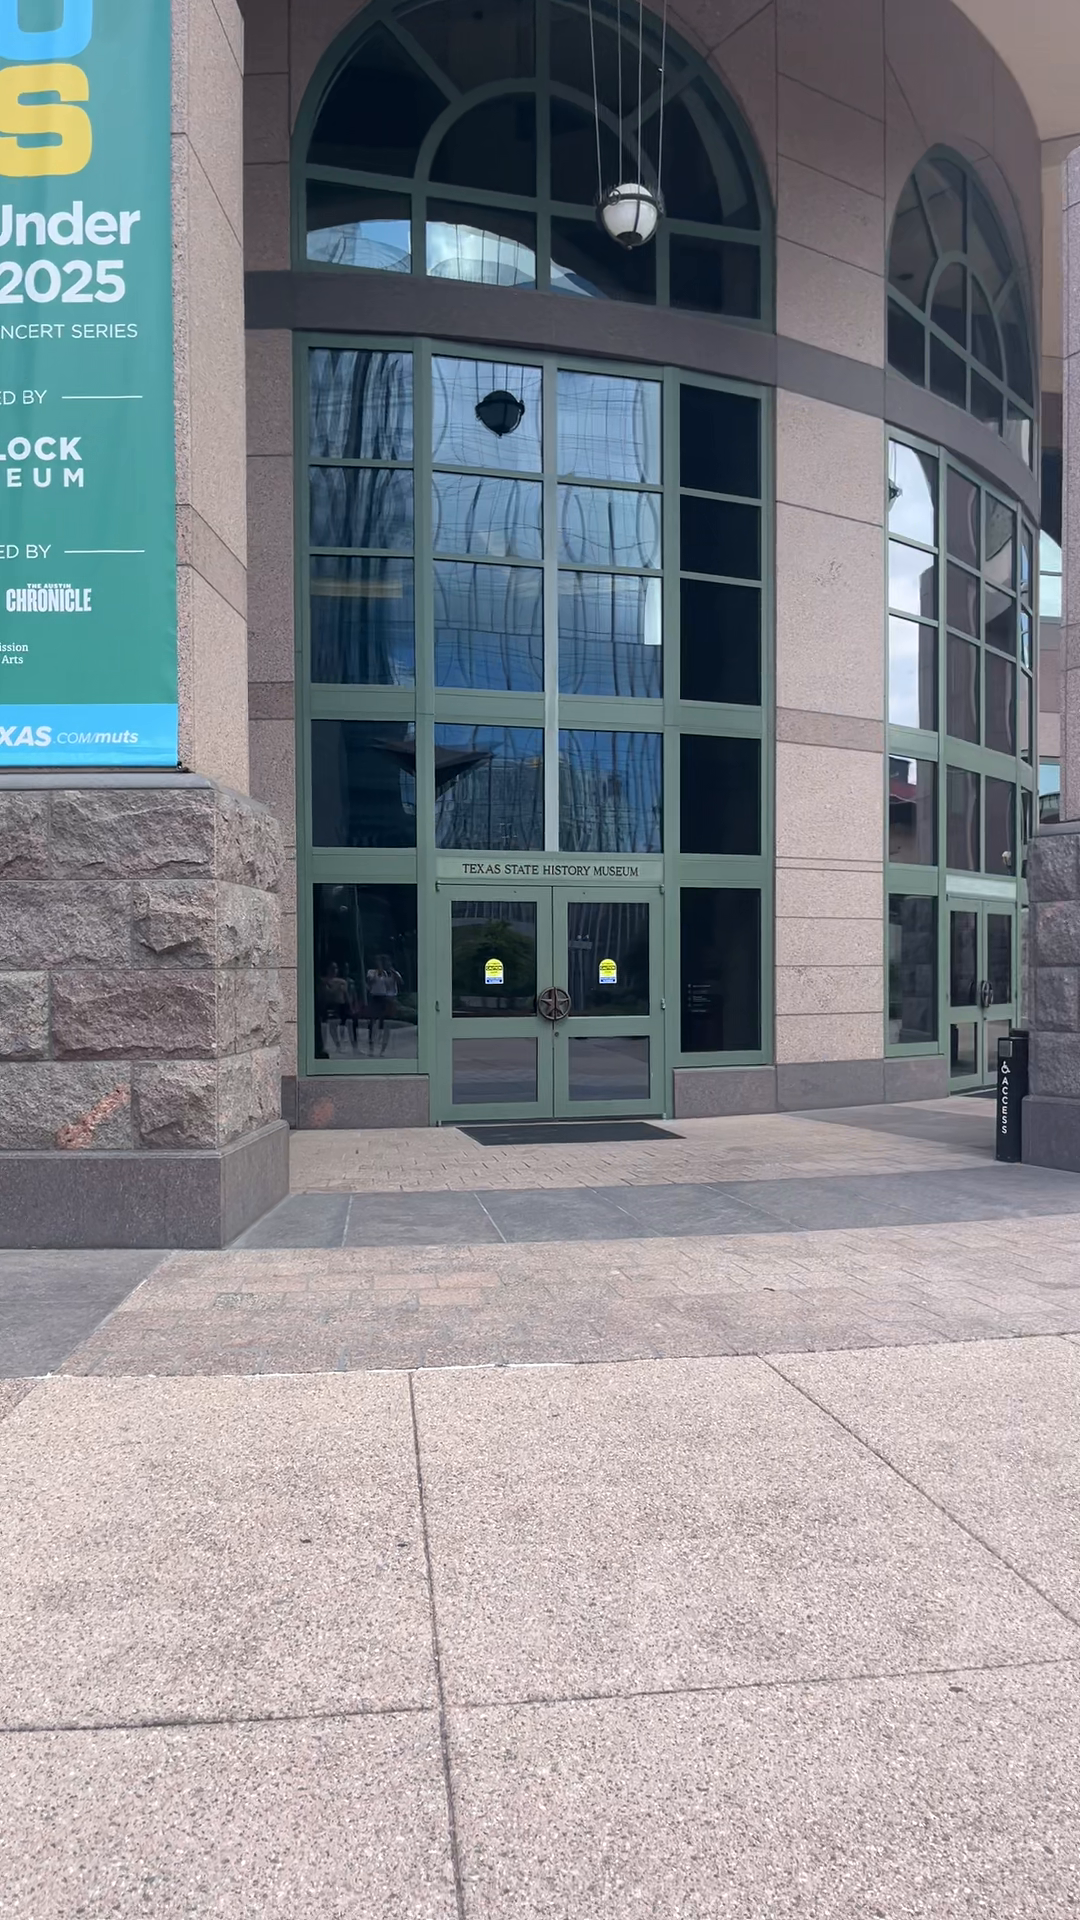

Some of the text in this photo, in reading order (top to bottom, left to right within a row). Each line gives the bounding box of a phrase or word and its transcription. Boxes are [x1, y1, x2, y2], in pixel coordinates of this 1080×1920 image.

[0, 63, 93, 177] S
[0, 259, 126, 304] 2025
[71, 323, 138, 339] SERIES
[22, 390, 47, 405] BY
[26, 544, 51, 559] BY
[6, 588, 92, 612] CHRONICLE
[1, 654, 24, 665] Arts
[462, 863, 639, 877] TEXAS STATE HISTORY MUSEUM
[1001, 1076, 1009, 1134] ACCESS
